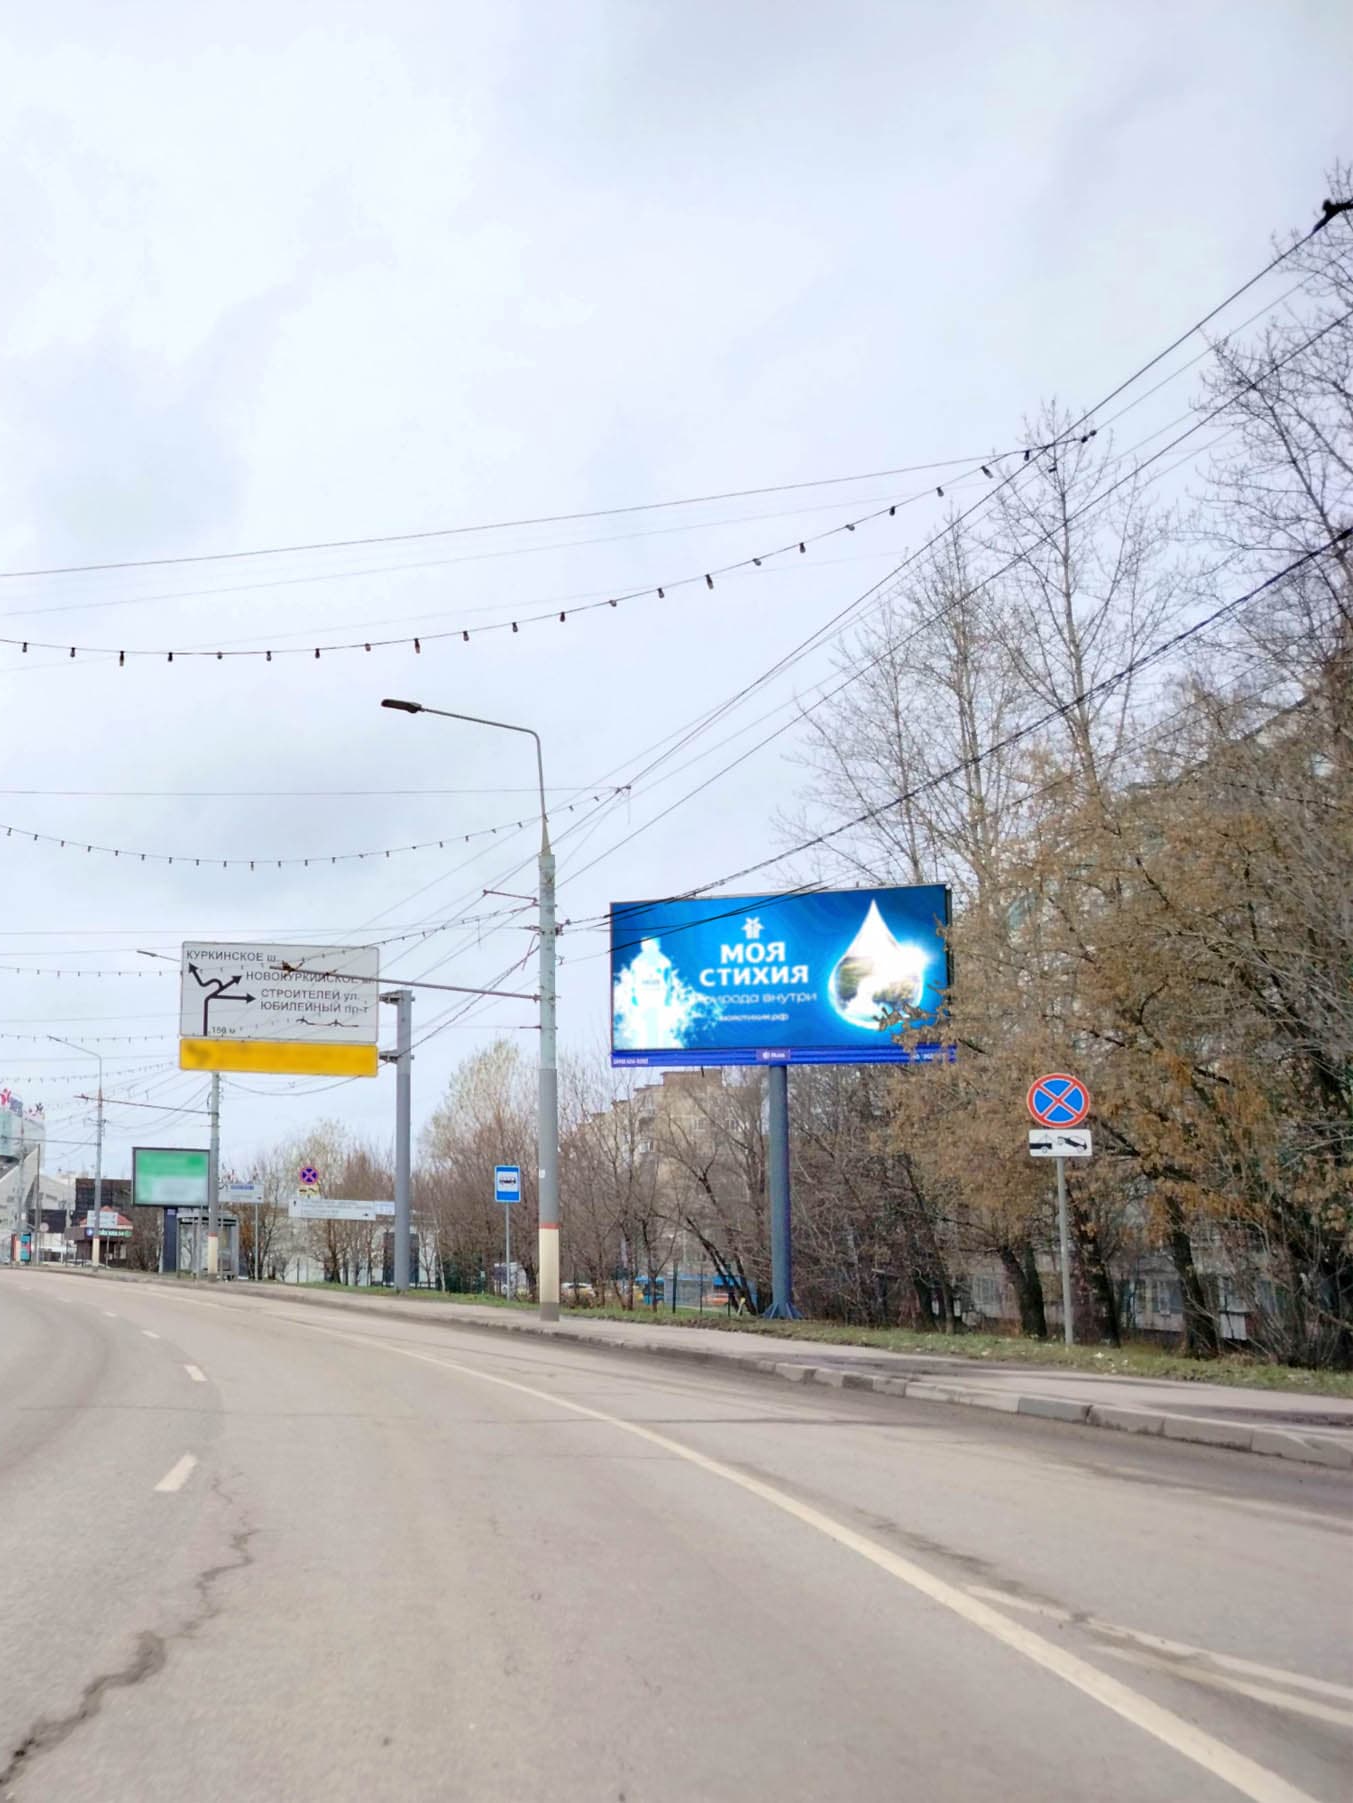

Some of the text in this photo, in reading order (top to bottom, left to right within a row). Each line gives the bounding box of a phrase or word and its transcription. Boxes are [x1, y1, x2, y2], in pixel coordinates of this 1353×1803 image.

[186, 951, 264, 962] КУРКИНСКОЕ
[720, 941, 786, 964] МОЯ
[699, 965, 810, 988] СТИХИЯ
[260, 988, 341, 1000] СТРОИТЕЛЕЙ
[762, 991, 818, 1005] внутри
[260, 1002, 368, 1015] ЮБИЛЕЙНЫЙ пр-т
